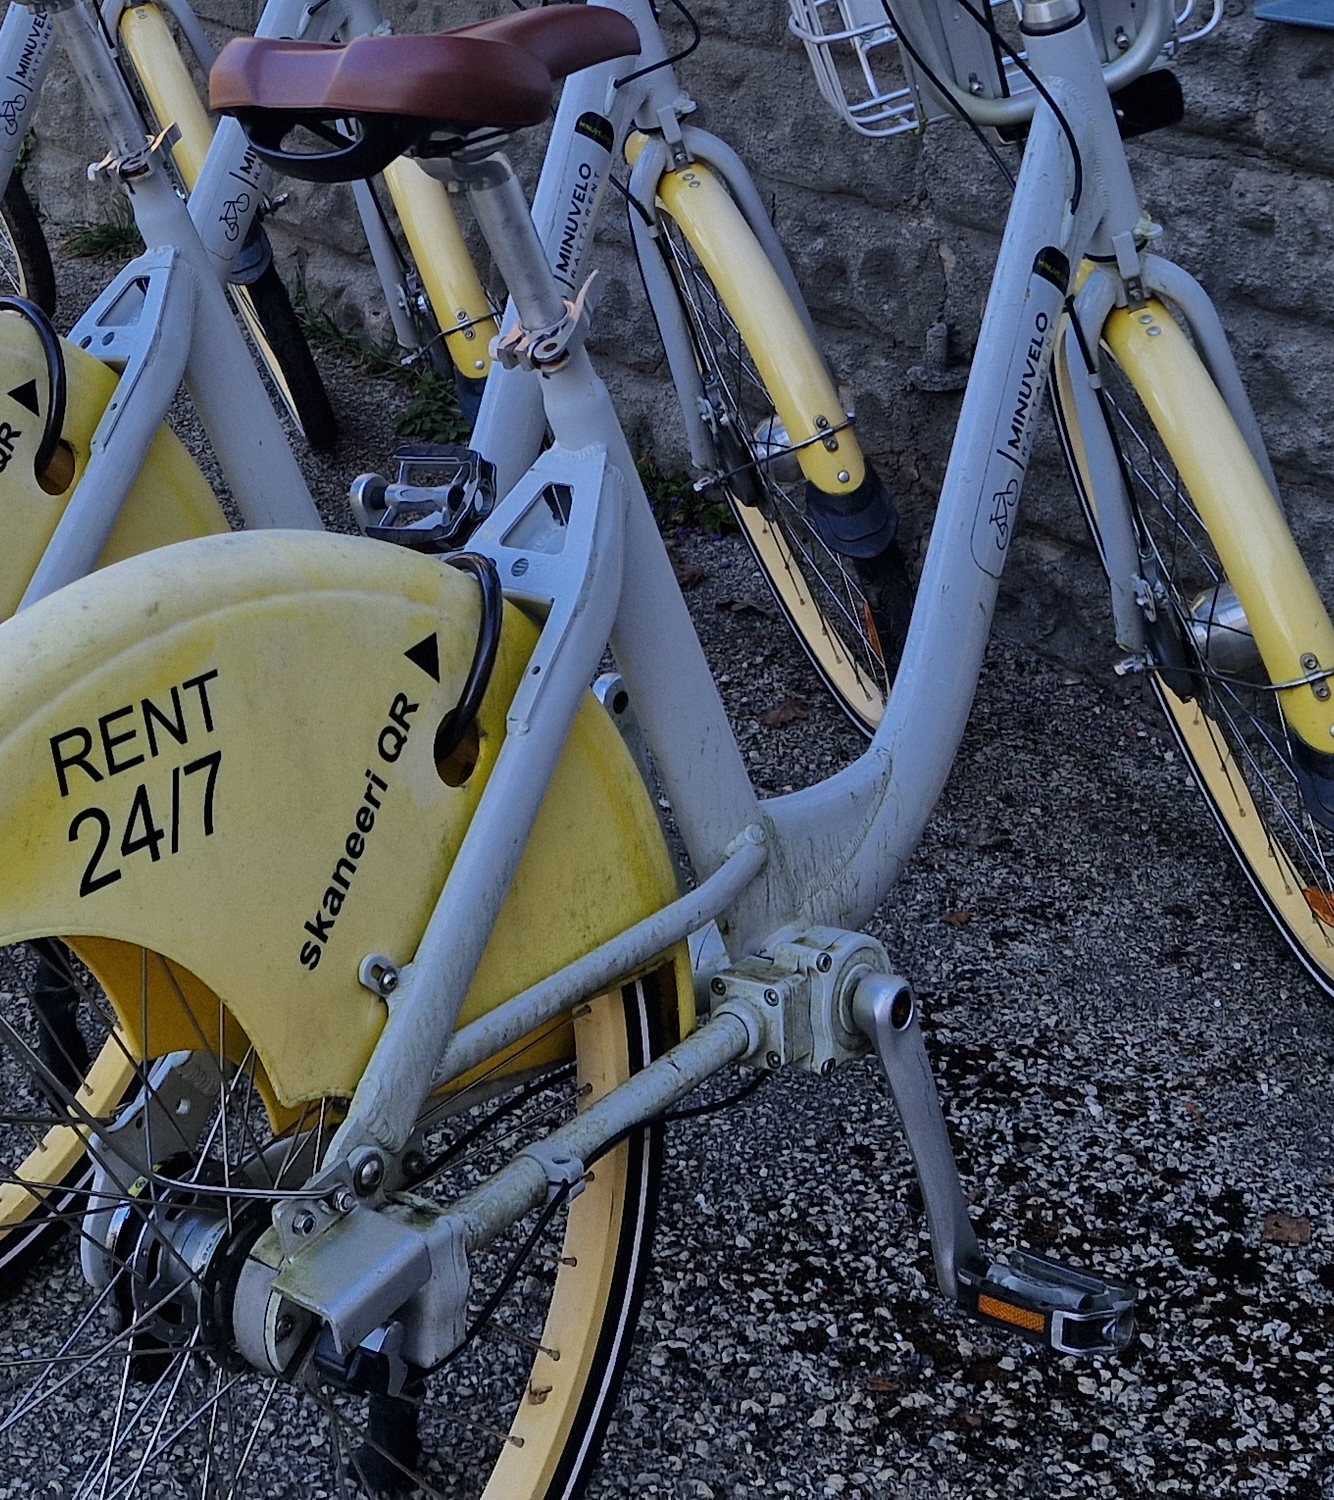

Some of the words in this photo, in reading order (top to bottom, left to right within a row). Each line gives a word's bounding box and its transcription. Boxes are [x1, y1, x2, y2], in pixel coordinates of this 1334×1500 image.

[15, 12, 48, 79] MINUVEL
[555, 163, 591, 274] MINUVELO
[570, 170, 600, 279] RATTARENT
[1008, 312, 1049, 451] MINUVELO
[49, 668, 219, 798] RENT
[68, 750, 222, 898] 24/7
[299, 769, 389, 971] skaneeri
[377, 692, 420, 763] QR
